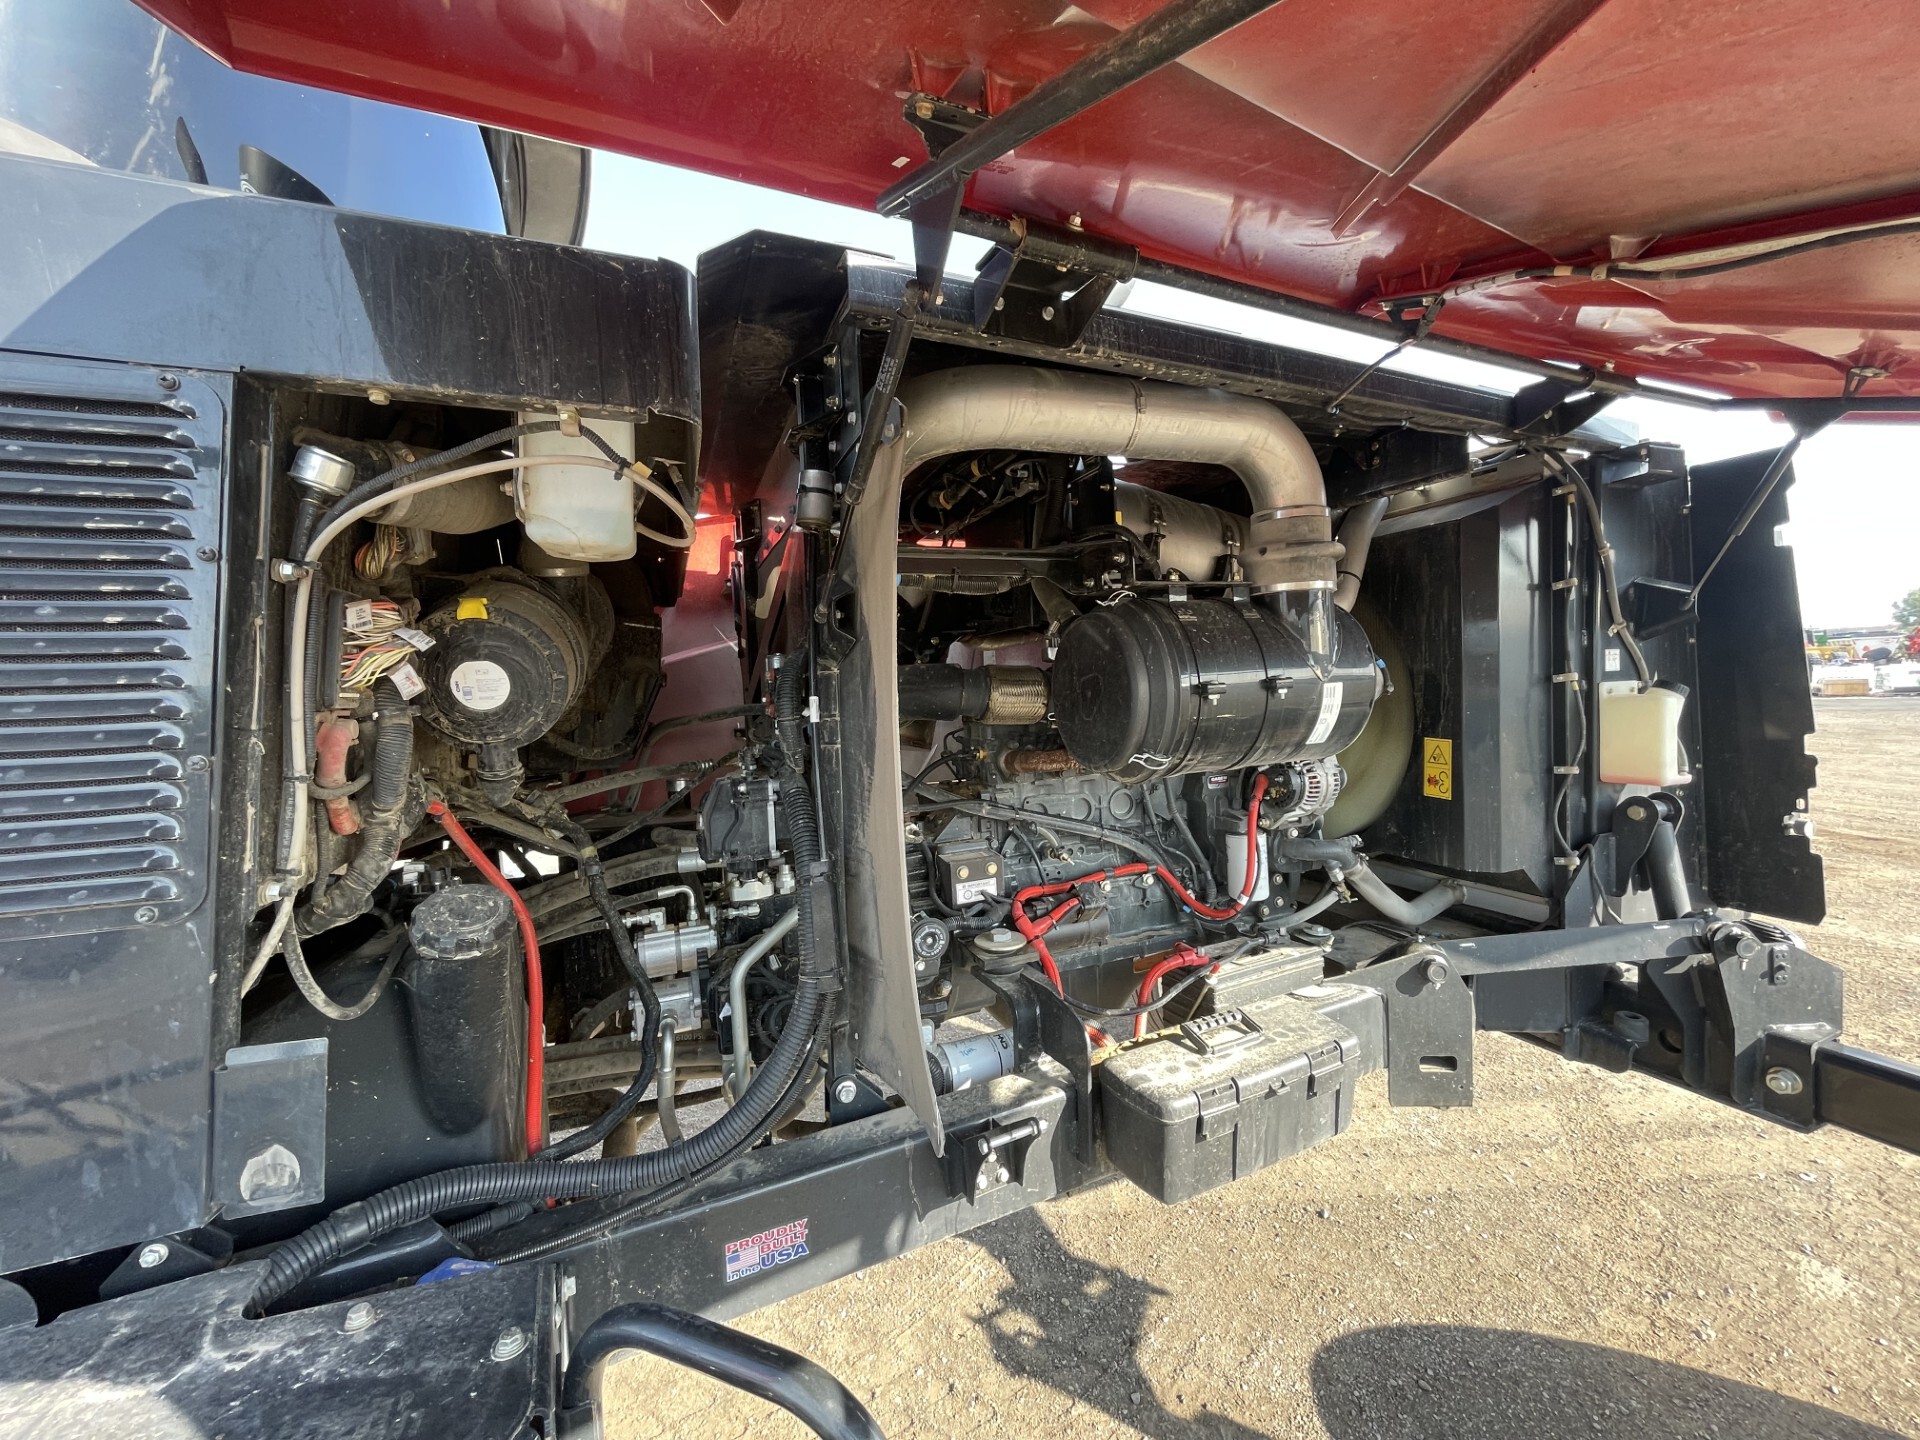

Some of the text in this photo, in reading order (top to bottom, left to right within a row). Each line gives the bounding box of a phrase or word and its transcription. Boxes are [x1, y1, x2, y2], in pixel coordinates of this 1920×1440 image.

[675, 1033, 692, 1042] 6100
[993, 1034, 1008, 1050] CNH
[725, 1218, 808, 1255] PROUDLY
[760, 1229, 809, 1254] BUILT
[728, 1242, 809, 1281] in the USA
